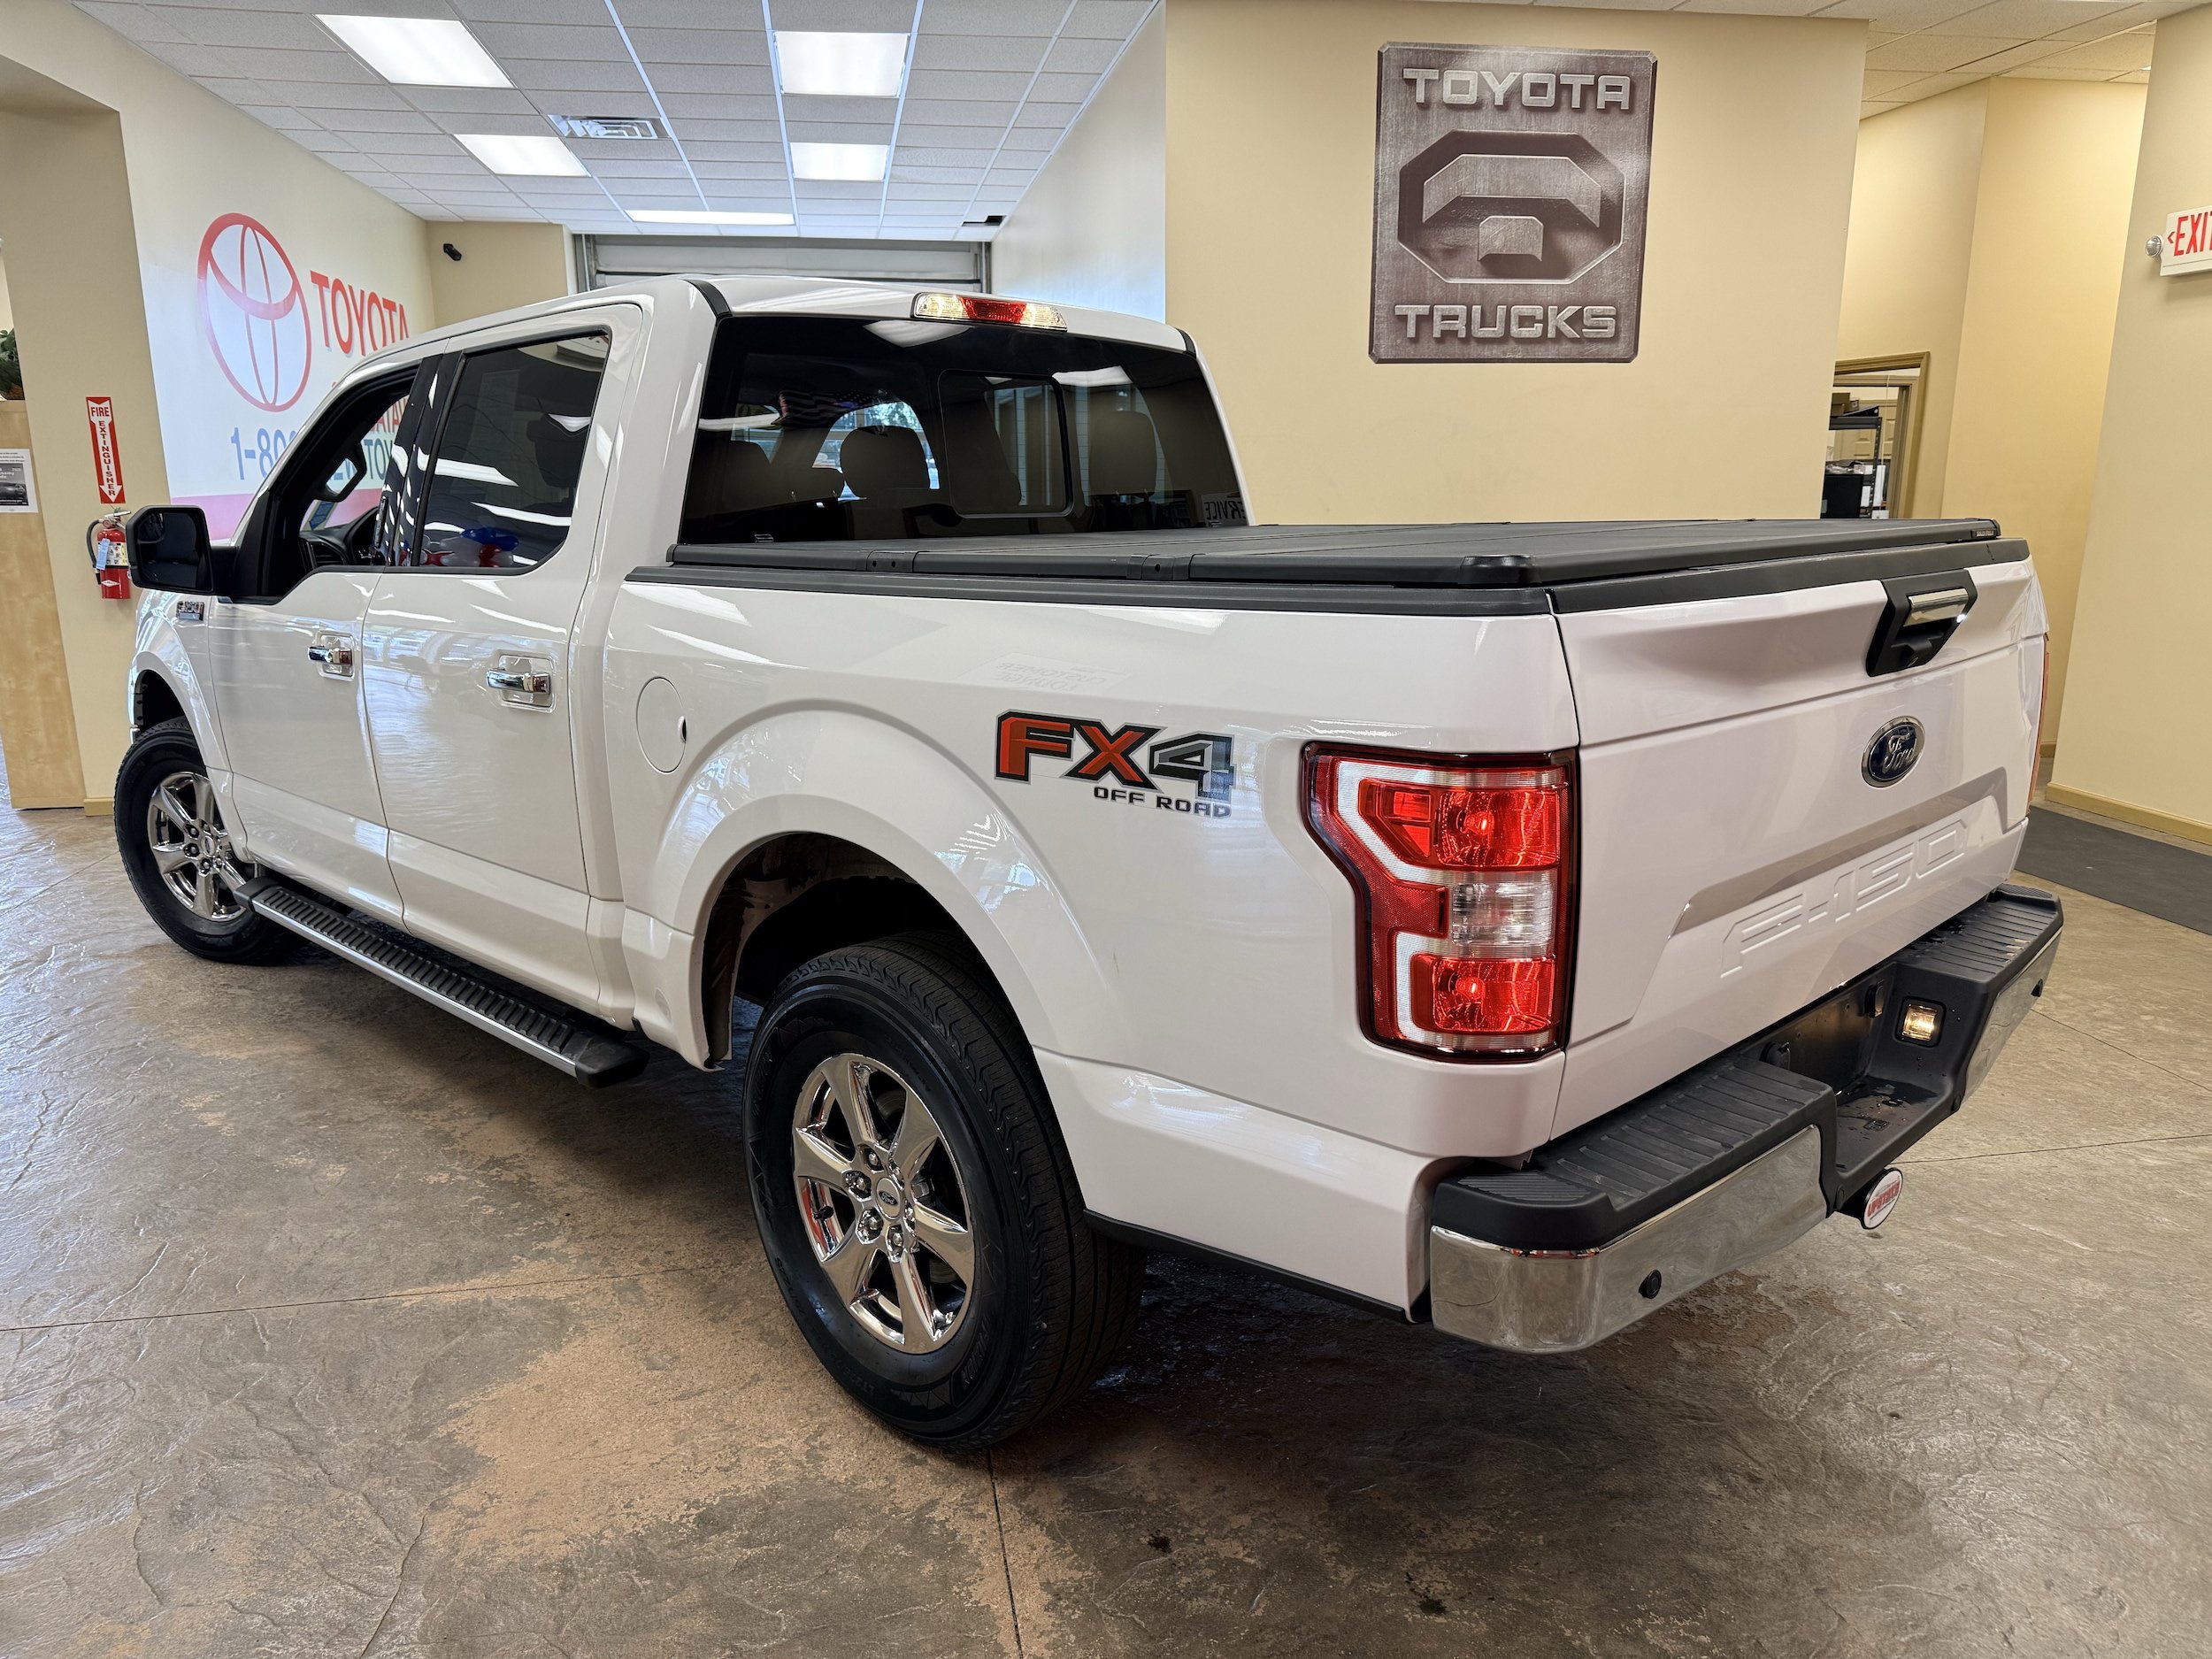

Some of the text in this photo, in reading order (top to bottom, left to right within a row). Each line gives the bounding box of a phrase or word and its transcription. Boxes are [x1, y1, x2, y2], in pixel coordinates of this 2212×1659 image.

[1402, 68, 1630, 110] TOYOTA
[1394, 305, 1617, 339] TRUCKS
[90, 407, 110, 417] FIRE
[99, 421, 116, 495] EXTINGUISHER
[230, 426, 297, 480] 1-80
[995, 709, 1236, 803] FX4
[1881, 732, 1917, 775] Ford
[1094, 786, 1233, 819] OFF ROAD
